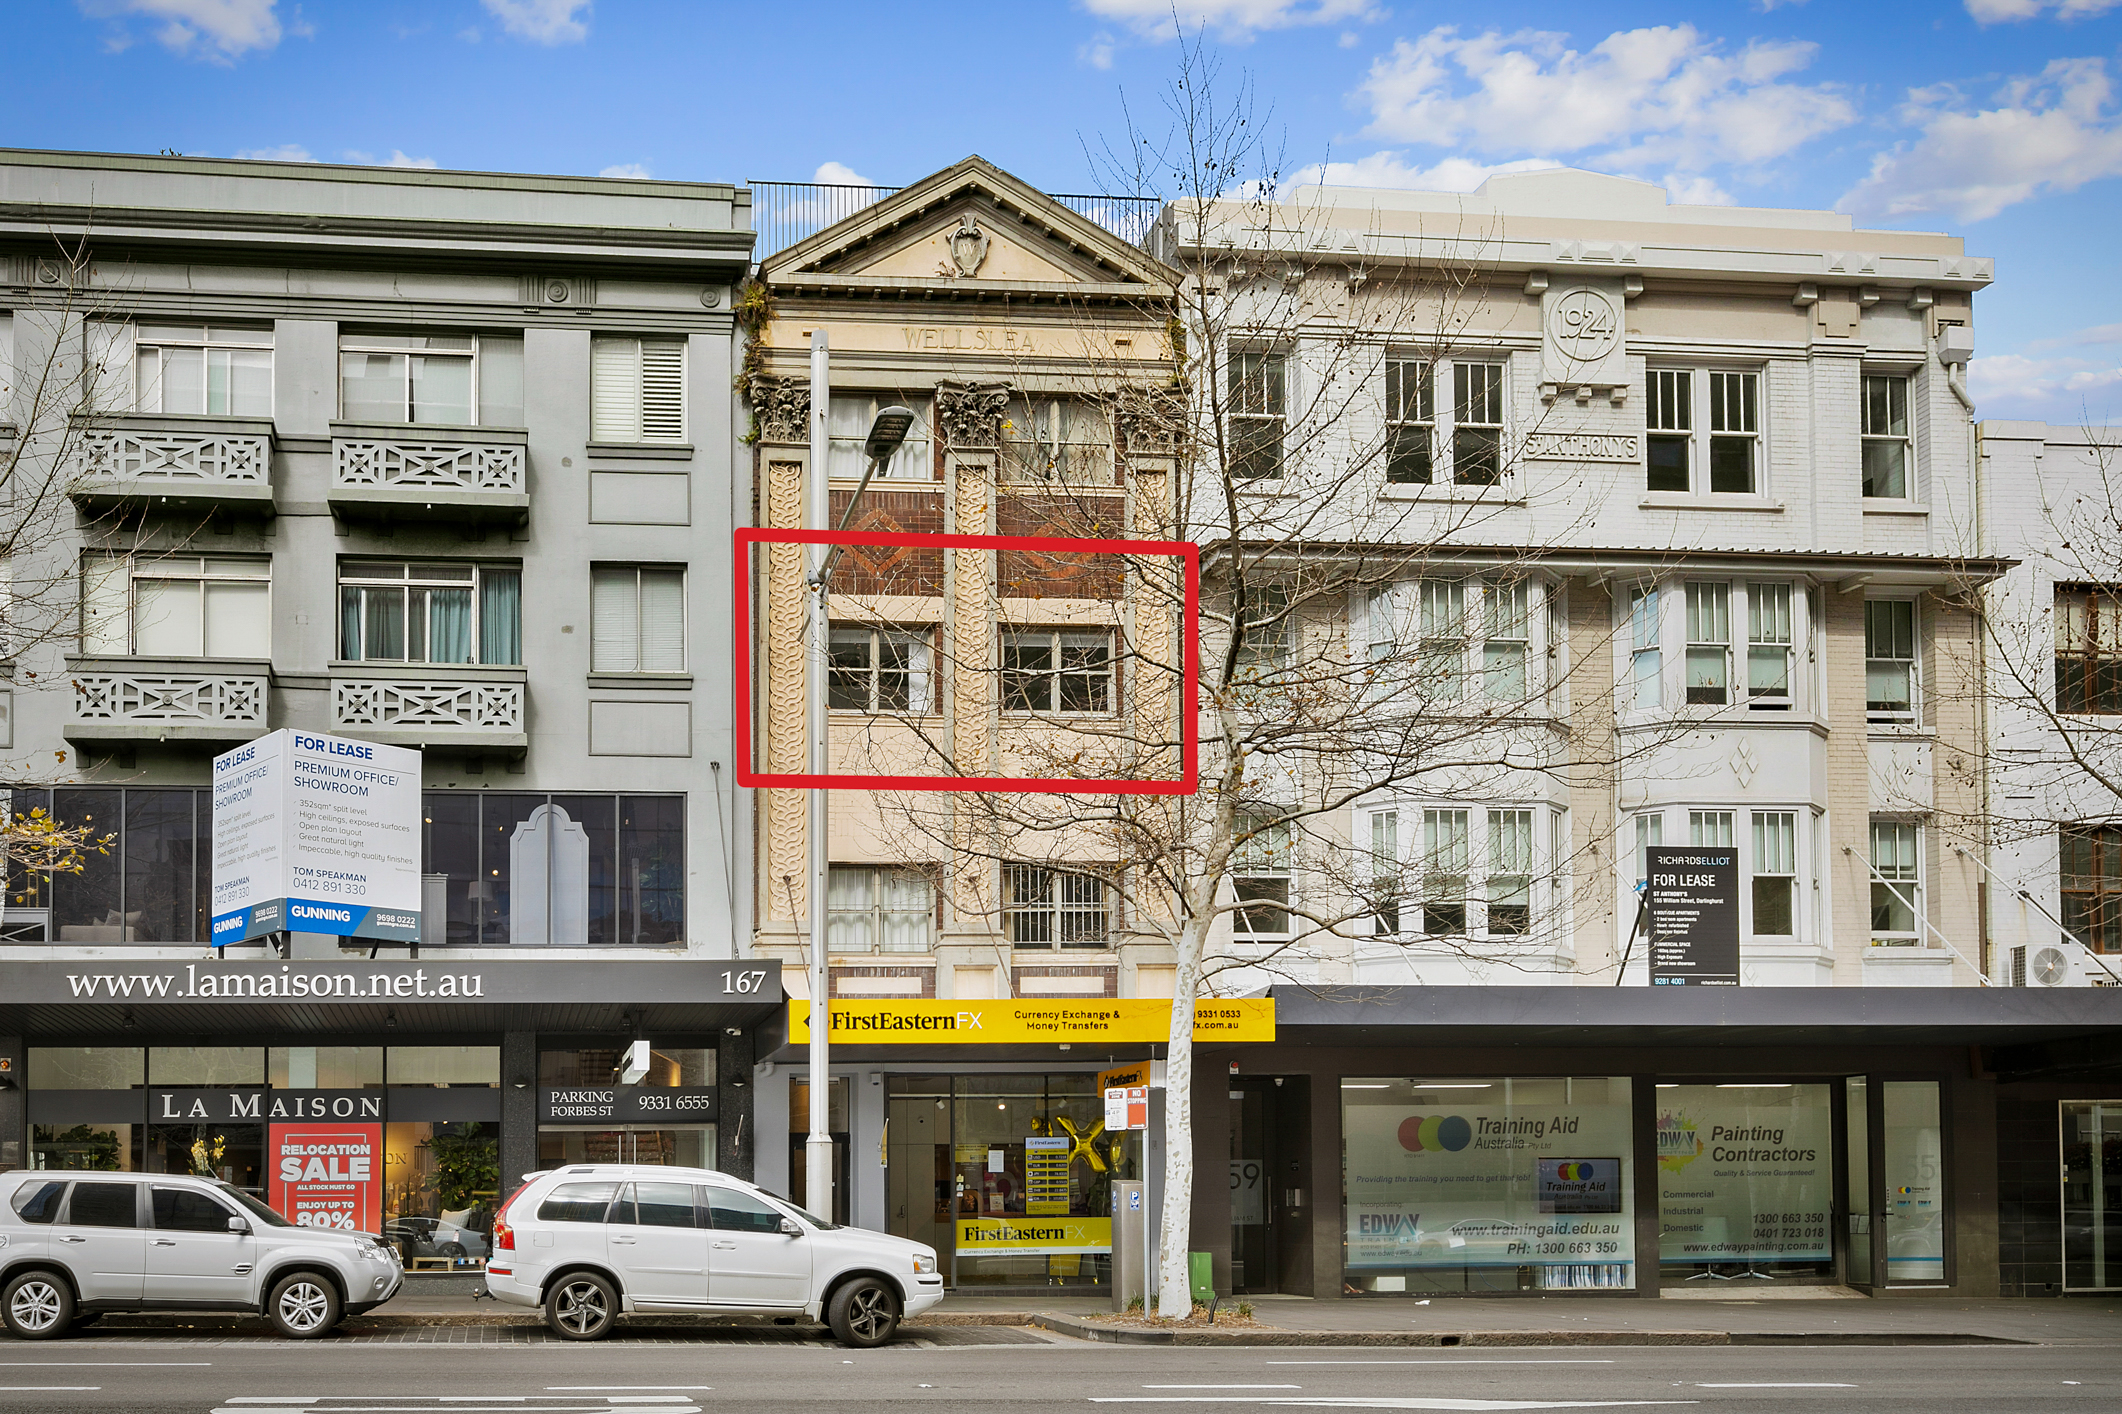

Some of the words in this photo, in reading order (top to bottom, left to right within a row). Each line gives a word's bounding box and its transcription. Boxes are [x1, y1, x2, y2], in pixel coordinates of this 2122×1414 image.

[1558, 307, 1614, 340] 1924
[901, 328, 1036, 352] WELLSLEA
[295, 735, 325, 752] FOR
[329, 741, 373, 760] LEASE
[215, 757, 231, 774] FOR
[232, 746, 256, 767] LEASE
[215, 776, 243, 795] PREMIUM
[243, 764, 269, 784] OFFICE/
[294, 760, 350, 779] PREMIUM
[353, 770, 400, 787] OFFICE/
[294, 776, 369, 797] SHOWROOM
[215, 787, 253, 810] SHOWROOM
[333, 804, 349, 814] split
[350, 807, 367, 816] level
[299, 810, 316, 820] High
[318, 814, 348, 825] ceilings,
[349, 818, 380, 828] exposed
[381, 822, 410, 833] surfaces
[299, 821, 320, 831] Open
[321, 825, 338, 833] plan
[339, 827, 362, 837] layout
[299, 832, 320, 842] Great
[321, 836, 347, 846] natural
[348, 839, 364, 848] light
[298, 843, 343, 857] Impeccable,
[344, 849, 360, 859] high
[361, 852, 386, 863] quality
[386, 854, 413, 865] finishes
[1657, 855, 1730, 866] RICHARDSELLIOT
[293, 866, 314, 877] TOM
[316, 869, 367, 883] SPEAKMAN
[1653, 874, 1677, 887] FOR
[1679, 874, 1716, 887] LEASE
[225, 875, 250, 891] SPEAKMAN
[293, 877, 319, 890] 0412
[323, 881, 342, 892] 891
[345, 883, 366, 896] 330
[291, 905, 351, 922] GUNNING
[376, 913, 396, 923] 9698
[397, 915, 416, 925] 0222
[213, 915, 243, 935] GUNNING
[66, 965, 484, 998] www.lamaison.net.au
[721, 970, 767, 994] 167
[831, 1011, 983, 1030] FirstEasternFX
[1014, 1010, 1060, 1020] Currency
[1062, 1010, 1111, 1020] Exchange
[1113, 1010, 1120, 1019] &
[1197, 1010, 1218, 1018] 9331
[1220, 1010, 1241, 1018] 0533
[1026, 1021, 1059, 1031] Money
[1062, 1021, 1109, 1030] Transfers
[1193, 1020, 1239, 1029] fx.com.au
[551, 1091, 614, 1103] PARKING
[1132, 1089, 1142, 1097] NO
[229, 1093, 382, 1118] MAISON
[638, 1095, 672, 1111] 9331
[675, 1095, 710, 1110] 6555
[551, 1106, 597, 1117] FORBES
[599, 1106, 614, 1116] ST
[1475, 1116, 1546, 1138] Training
[1549, 1116, 1579, 1134] Aid
[1711, 1126, 1784, 1145] Painting
[281, 1144, 371, 1156] RELOCATION
[1474, 1137, 1525, 1150] Australia
[1528, 1142, 1542, 1151] Pty
[1712, 1146, 1816, 1162] Contractors
[279, 1156, 371, 1182] SALE
[1230, 1163, 1261, 1189] 59
[1713, 1169, 1738, 1178] Quality
[1356, 1175, 1393, 1184] Providing
[1408, 1175, 1437, 1184] training
[1515, 1175, 1531, 1183] job!
[1546, 1182, 1587, 1193] Training
[1589, 1181, 1606, 1192] Aid
[1663, 1190, 1714, 1198] Commercial
[297, 1201, 328, 1210] ENJOY
[328, 1201, 341, 1209] UP
[341, 1201, 355, 1209] TO
[1360, 1201, 1404, 1209] Incorporating:
[1663, 1207, 1704, 1215] Industrial
[296, 1211, 355, 1231] 80%
[1360, 1213, 1420, 1236] EDWAY
[1753, 1214, 1778, 1223] 1300
[1782, 1214, 1801, 1223] 663
[1804, 1213, 1824, 1223] 350
[964, 1225, 1086, 1241] FirstEasternFX
[1452, 1223, 1620, 1239] www.trainingaid.edu.au
[1663, 1224, 1704, 1232] Domestic
[1753, 1228, 1778, 1239] 0401
[1782, 1228, 1801, 1238] 723
[1804, 1228, 1824, 1238] 018
[1507, 1243, 1530, 1255] PH:
[1535, 1242, 1565, 1255] 1300
[1568, 1242, 1591, 1254] 663
[1594, 1241, 1618, 1253] 350
[1683, 1242, 1824, 1253] www.edwaypainting.com.au
